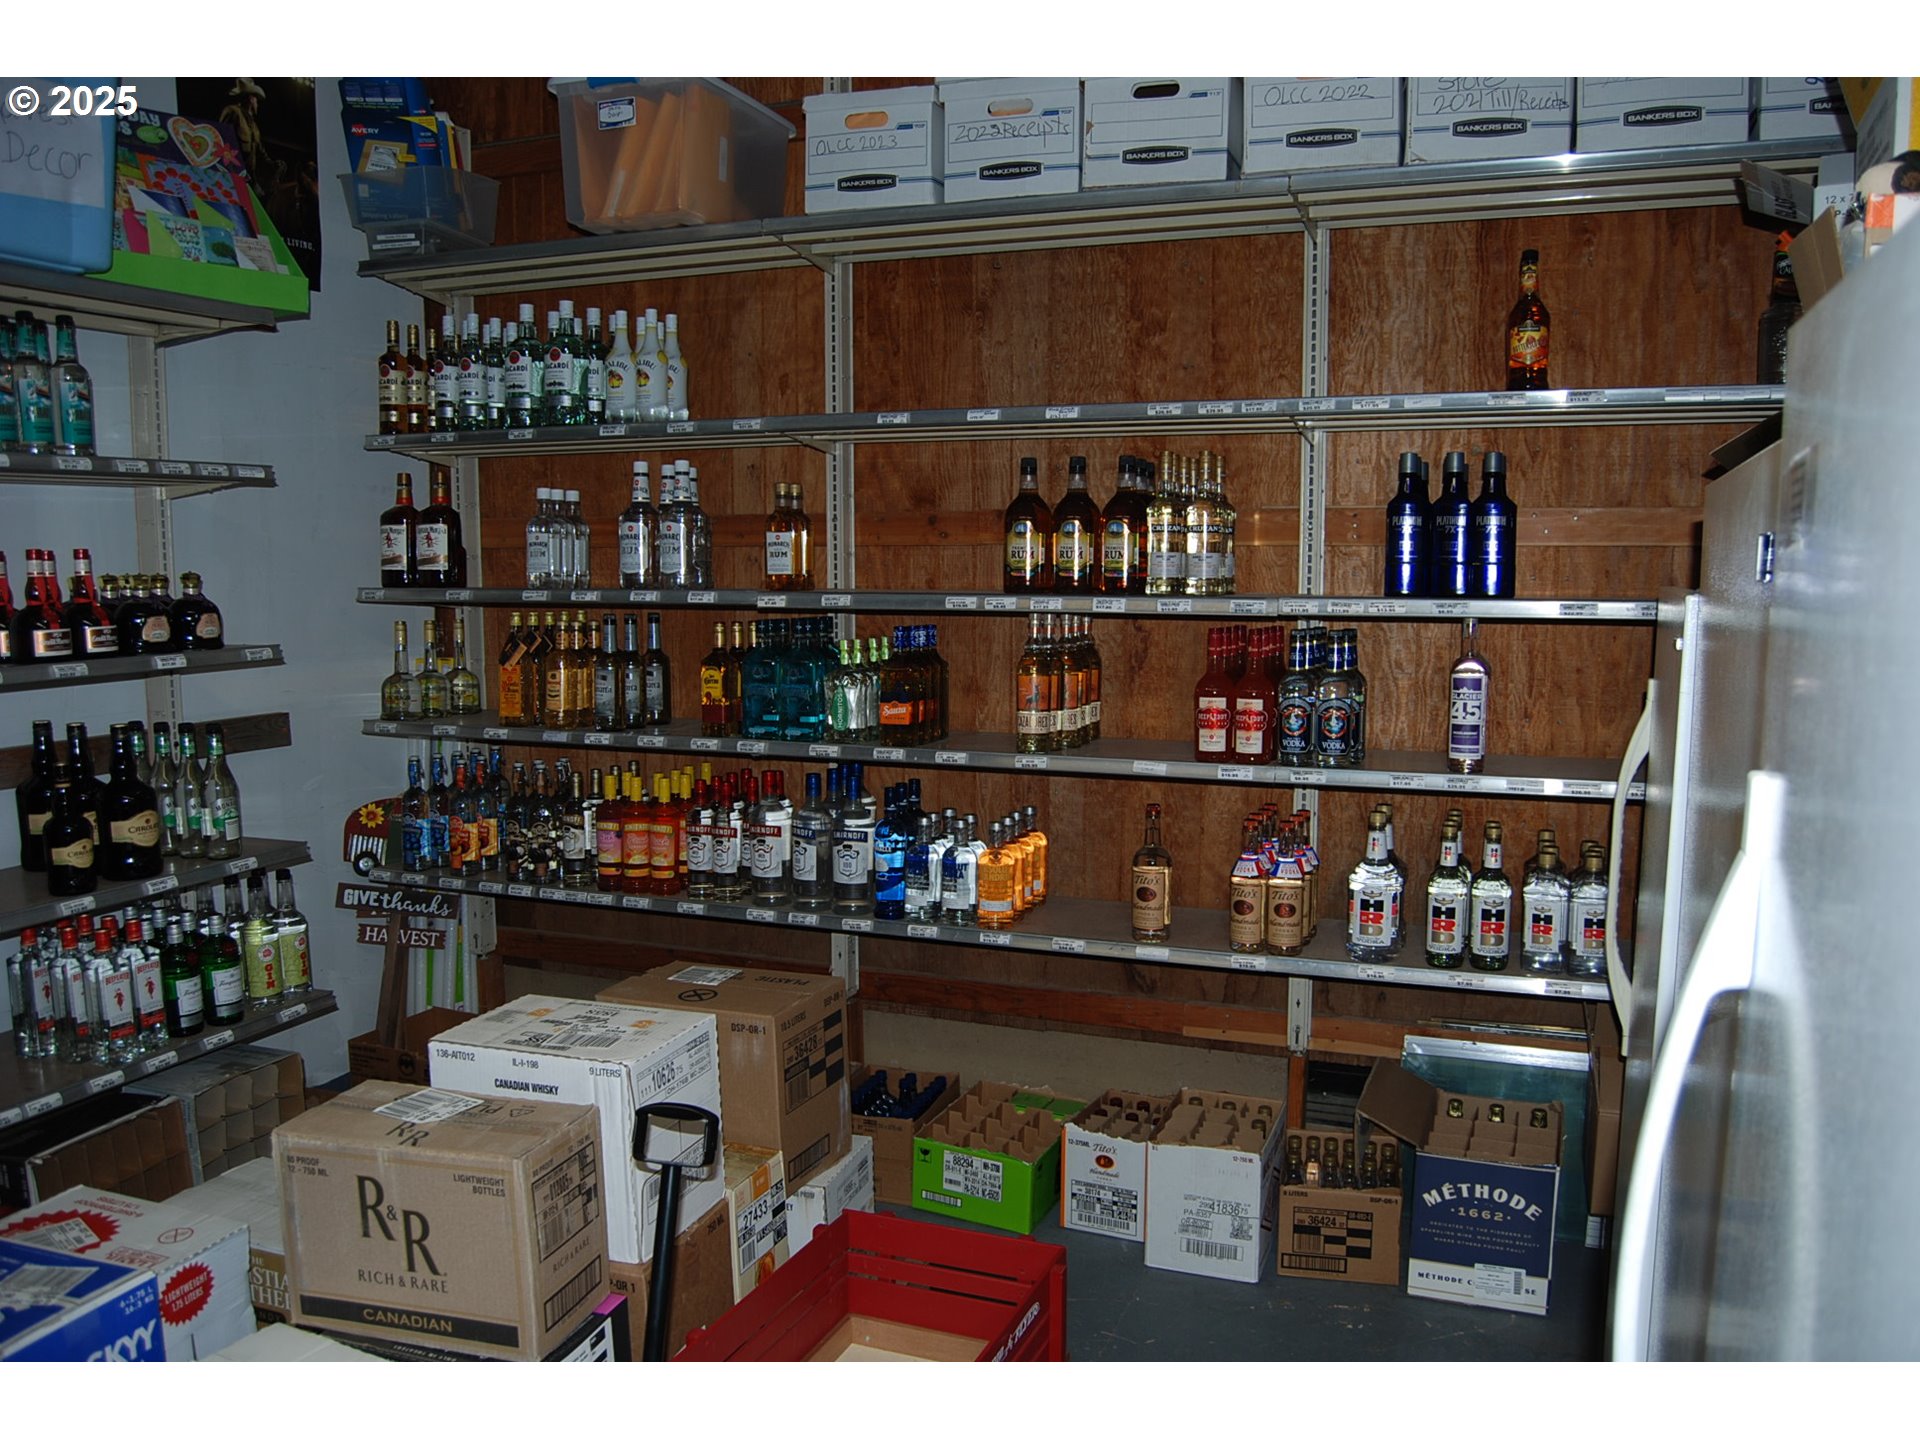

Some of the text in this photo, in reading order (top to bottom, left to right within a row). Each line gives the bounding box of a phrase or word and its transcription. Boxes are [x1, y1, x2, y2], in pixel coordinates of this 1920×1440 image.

[1318, 84, 1375, 102] 2022
[1626, 110, 1699, 123] BANKERS BOX
[351, 126, 379, 136] AVERY
[1455, 122, 1523, 133] BANKERS BOX
[859, 135, 898, 150] 2023
[1290, 132, 1355, 144] BANKERS BOX
[6, 131, 93, 180] Decor
[1125, 150, 1185, 162] BANKERS BOX
[982, 165, 1038, 177] BANKERS BOX
[840, 177, 894, 188] BANKERS BOX
[1825, 195, 1837, 205] 12
[1011, 550, 1035, 560] RUM
[1059, 550, 1083, 560] RUM
[1452, 701, 1482, 720] 45
[1283, 738, 1306, 748] VODKA
[1322, 741, 1345, 751] VODKA
[1135, 875, 1160, 885] Tito's
[1231, 887, 1257, 898] Tito's
[1272, 890, 1300, 900] Tito's
[343, 888, 379, 906] GIVE
[379, 890, 453, 917] thanks
[364, 926, 440, 947] HAVEST
[299, 951, 308, 977] GIN
[265, 963, 275, 989] GIN
[589, 1066, 621, 1079] 9 LITERS
[651, 1061, 675, 1092] 10626
[494, 1078, 559, 1096] CANADIAN WHISKY
[1093, 1142, 1118, 1155] Tito's
[296, 1157, 320, 1167] PROOF
[302, 1167, 317, 1176] 750
[1089, 1167, 1120, 1179] Handmade
[453, 1173, 505, 1188] LIGHTWEIGHT
[472, 1185, 506, 1198] BOTTLES
[1422, 1182, 1543, 1222] MÉTHODE
[743, 1199, 769, 1231] 27433
[1457, 1205, 1504, 1221] 1662
[1307, 1215, 1337, 1227] 36424
[357, 1269, 449, 1294] RICH & RARE
[1418, 1271, 1463, 1284] MÉTHODE
[164, 1271, 208, 1305] LIGHTWEIGHT
[185, 1287, 204, 1306] LITERS
[362, 1307, 453, 1333] CANADIAN
